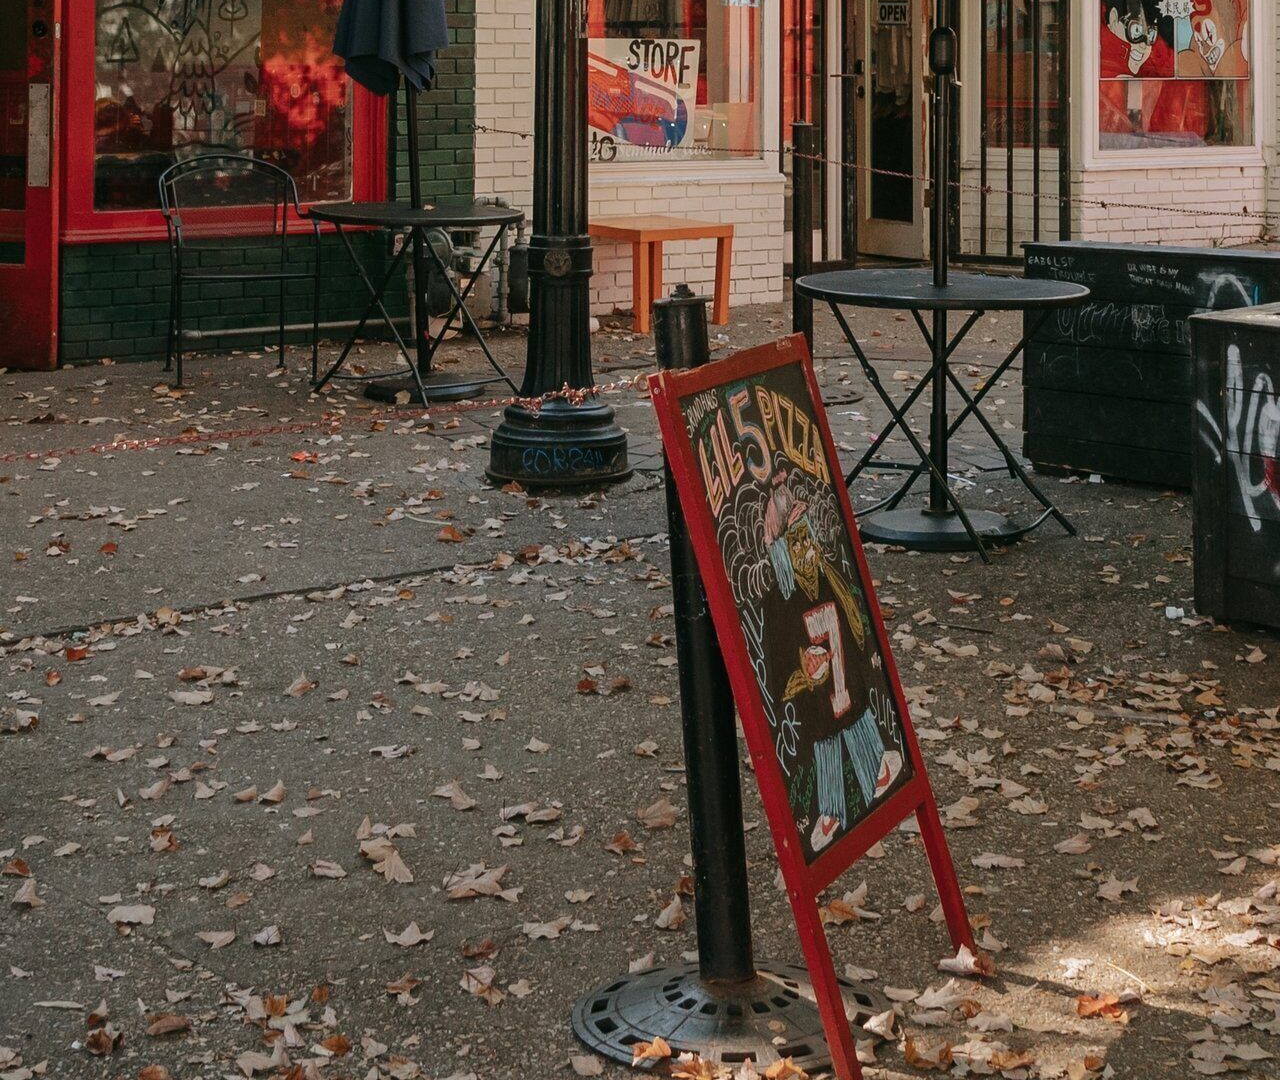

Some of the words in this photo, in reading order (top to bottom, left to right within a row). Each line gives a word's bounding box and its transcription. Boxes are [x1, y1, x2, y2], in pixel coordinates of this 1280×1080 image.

[879, 4, 907, 21] OPEN
[627, 39, 696, 88] STORE
[698, 408, 745, 518] LIL
[726, 385, 772, 485] 5
[755, 385, 831, 485] PIZZA
